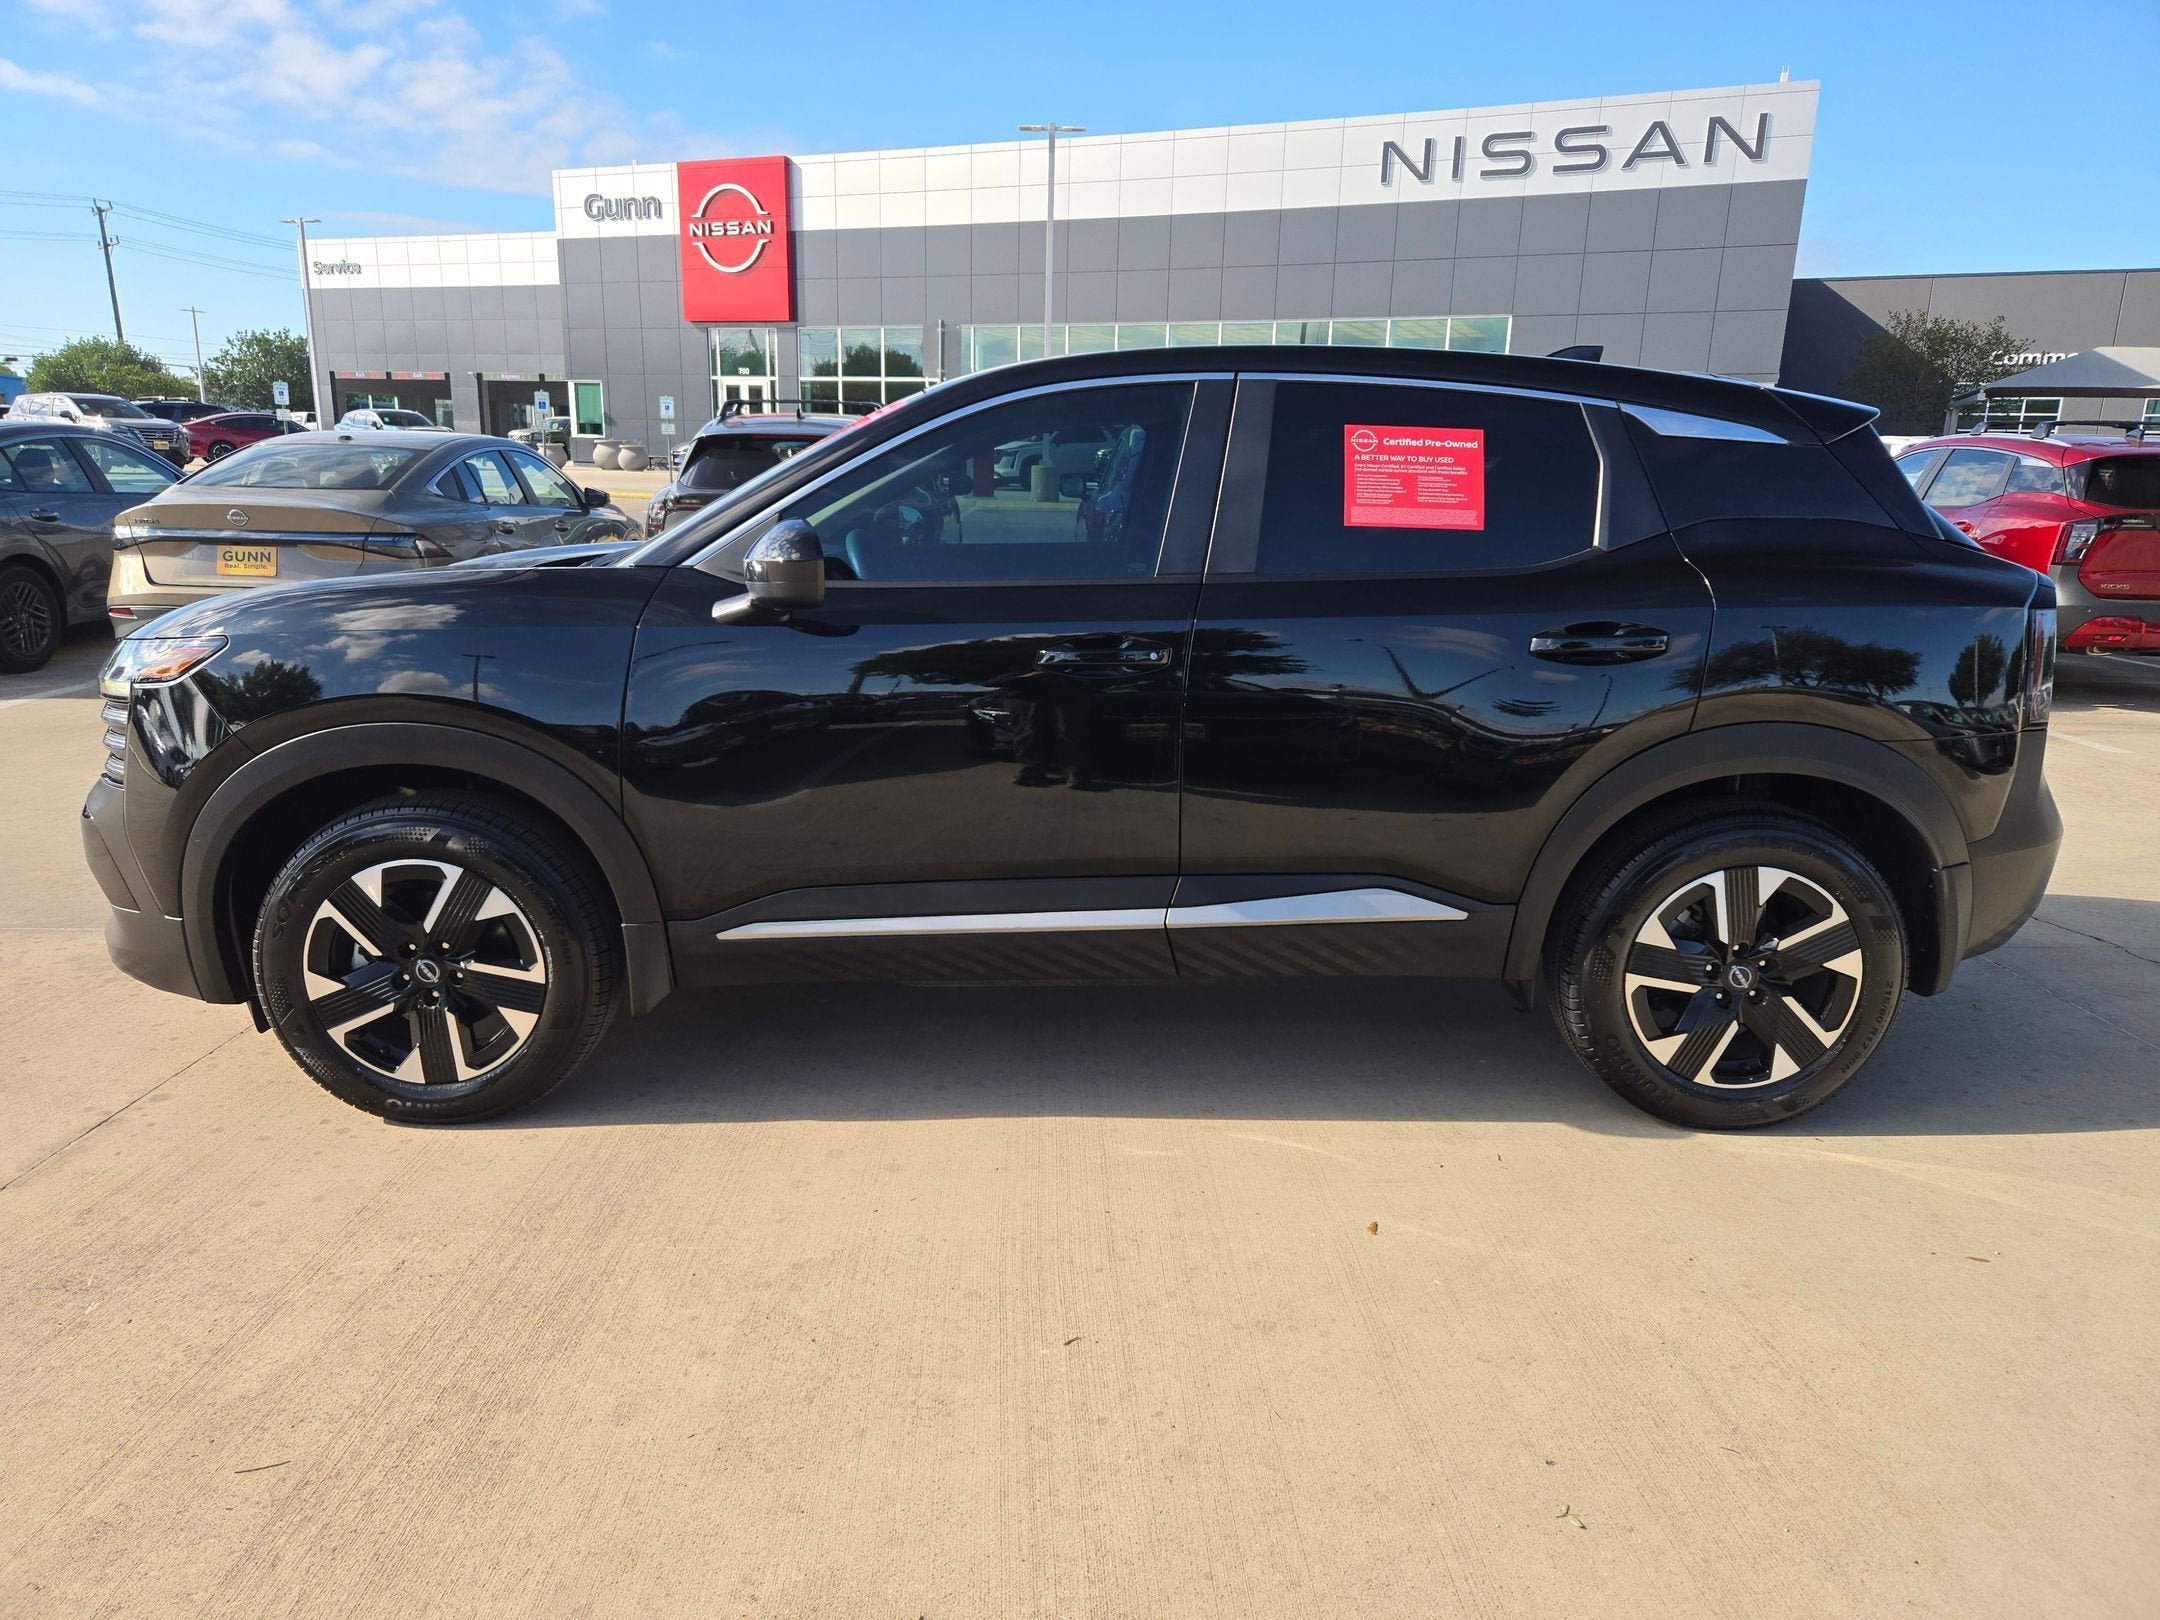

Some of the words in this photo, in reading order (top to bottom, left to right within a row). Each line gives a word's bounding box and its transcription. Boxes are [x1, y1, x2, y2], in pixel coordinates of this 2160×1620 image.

[1380, 112, 1773, 185] NISSAN
[583, 193, 663, 221] Gunn
[689, 219, 773, 237] NISSAN
[312, 259, 362, 275] Service
[1989, 350, 2080, 366] Comm
[737, 367, 750, 375] 750
[1383, 437, 1423, 446] Certified
[1424, 439, 1478, 449] Pre-Owned
[223, 551, 271, 562] GUNN
